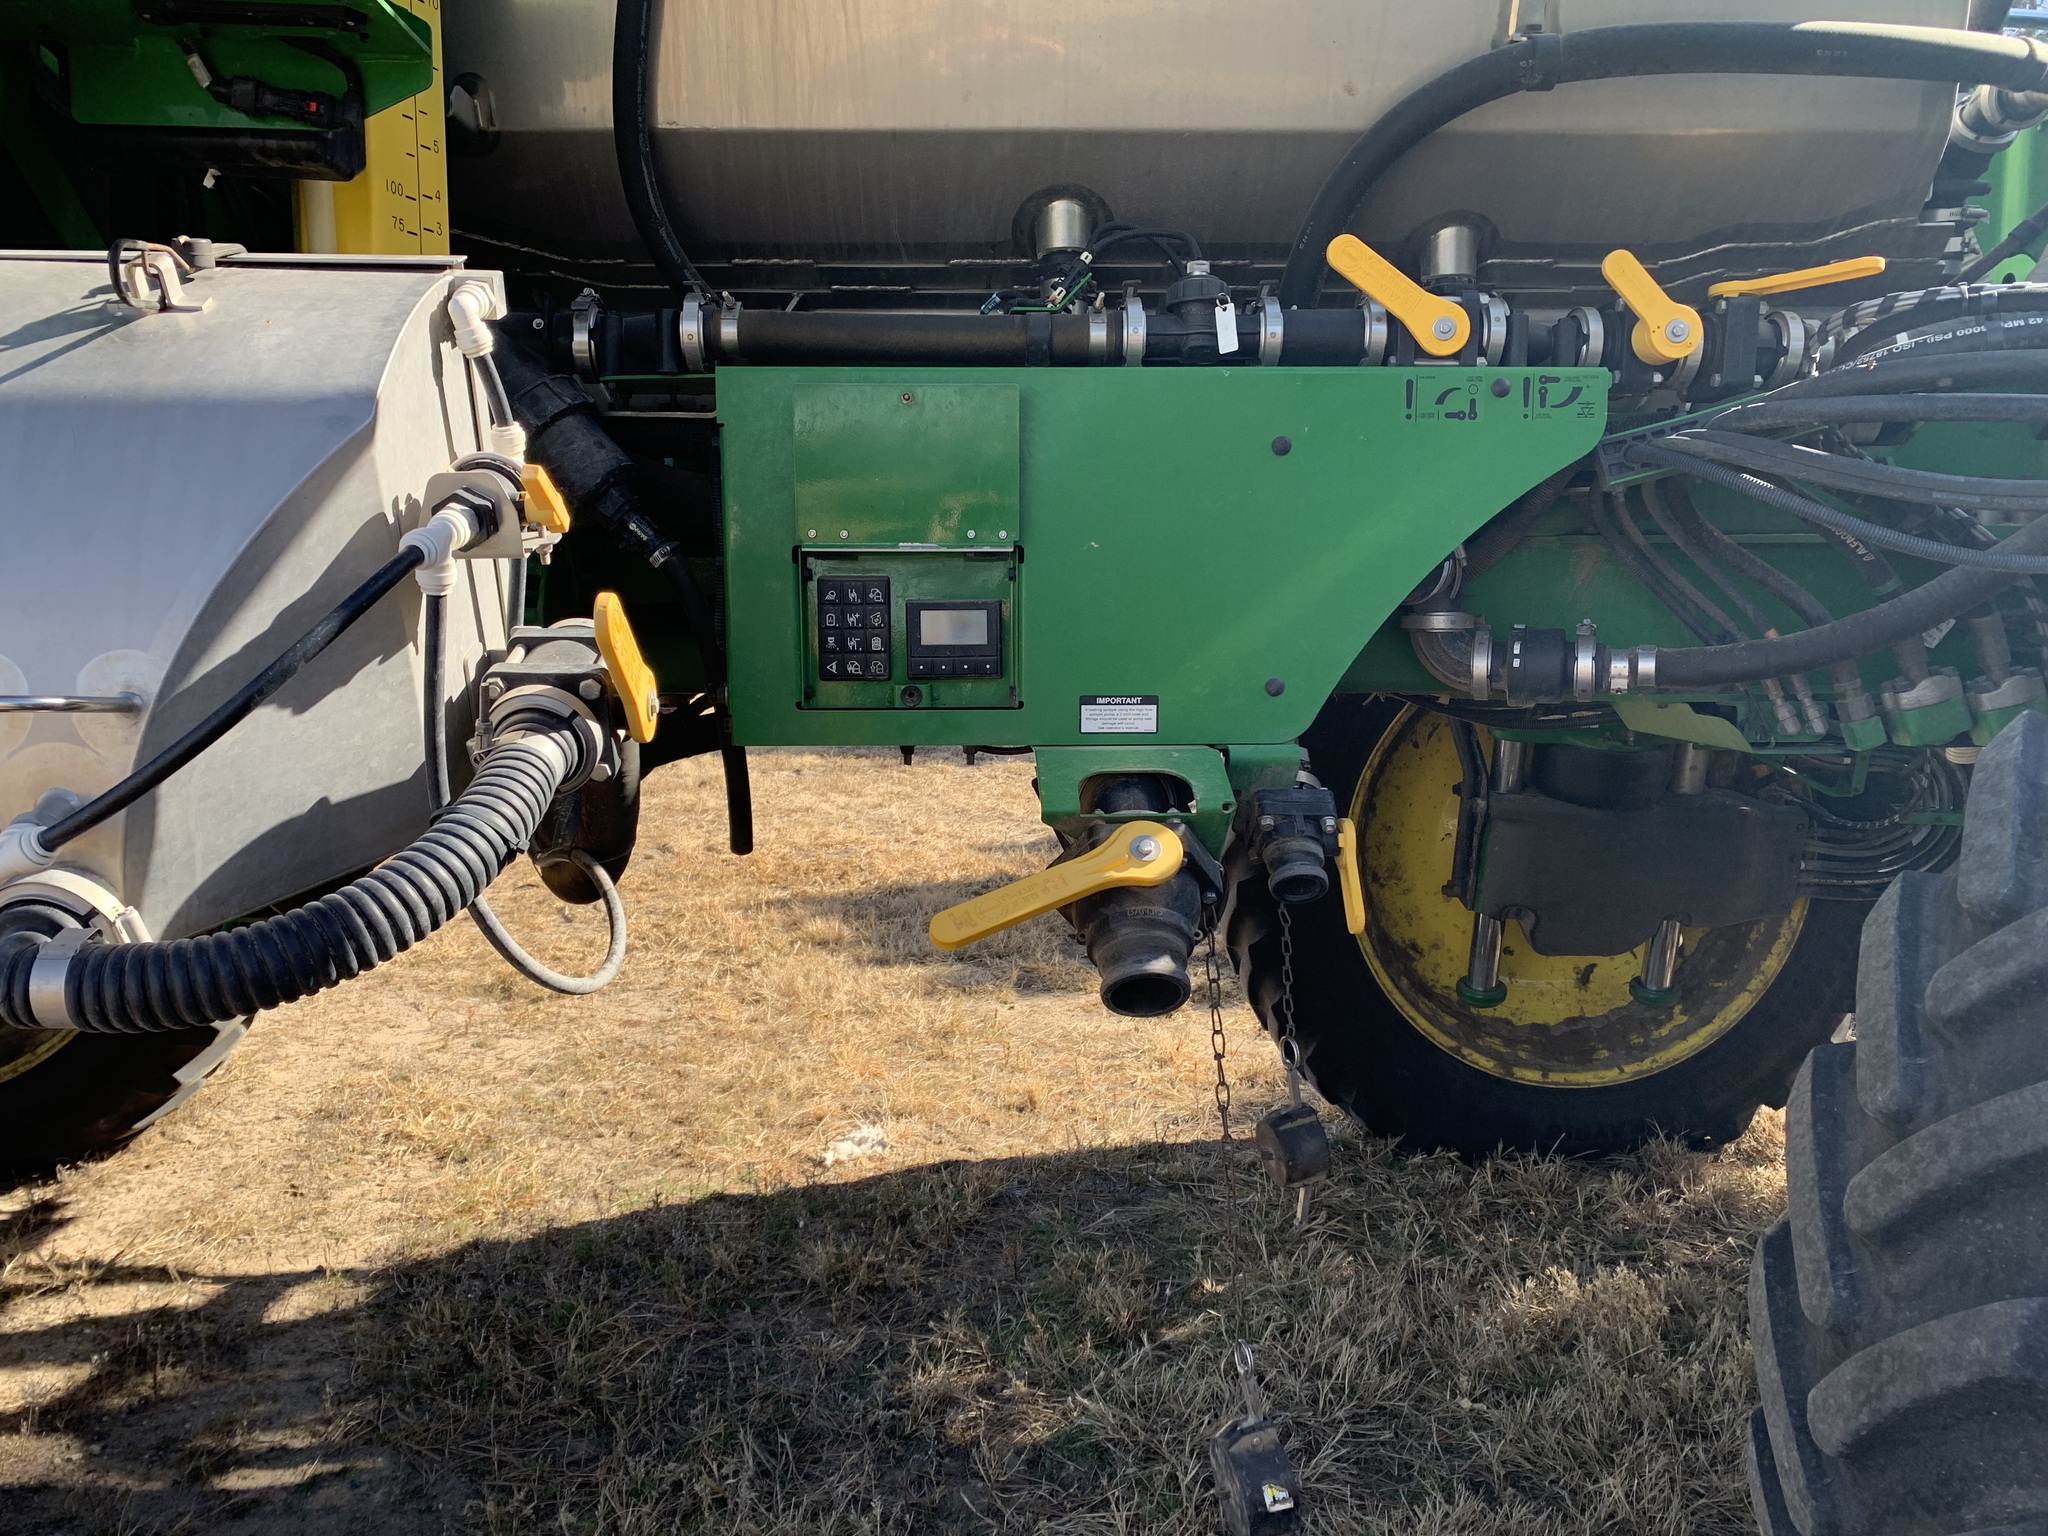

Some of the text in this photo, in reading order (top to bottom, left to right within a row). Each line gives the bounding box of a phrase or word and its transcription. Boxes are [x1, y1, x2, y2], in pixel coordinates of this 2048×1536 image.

[433, 140, 440, 154] 5
[385, 178, 404, 197] 100
[434, 189, 442, 203] 4
[391, 215, 405, 232] 75
[436, 221, 443, 236] 3
[2027, 316, 2044, 326] 42
[1127, 907, 1163, 916] BANJO
